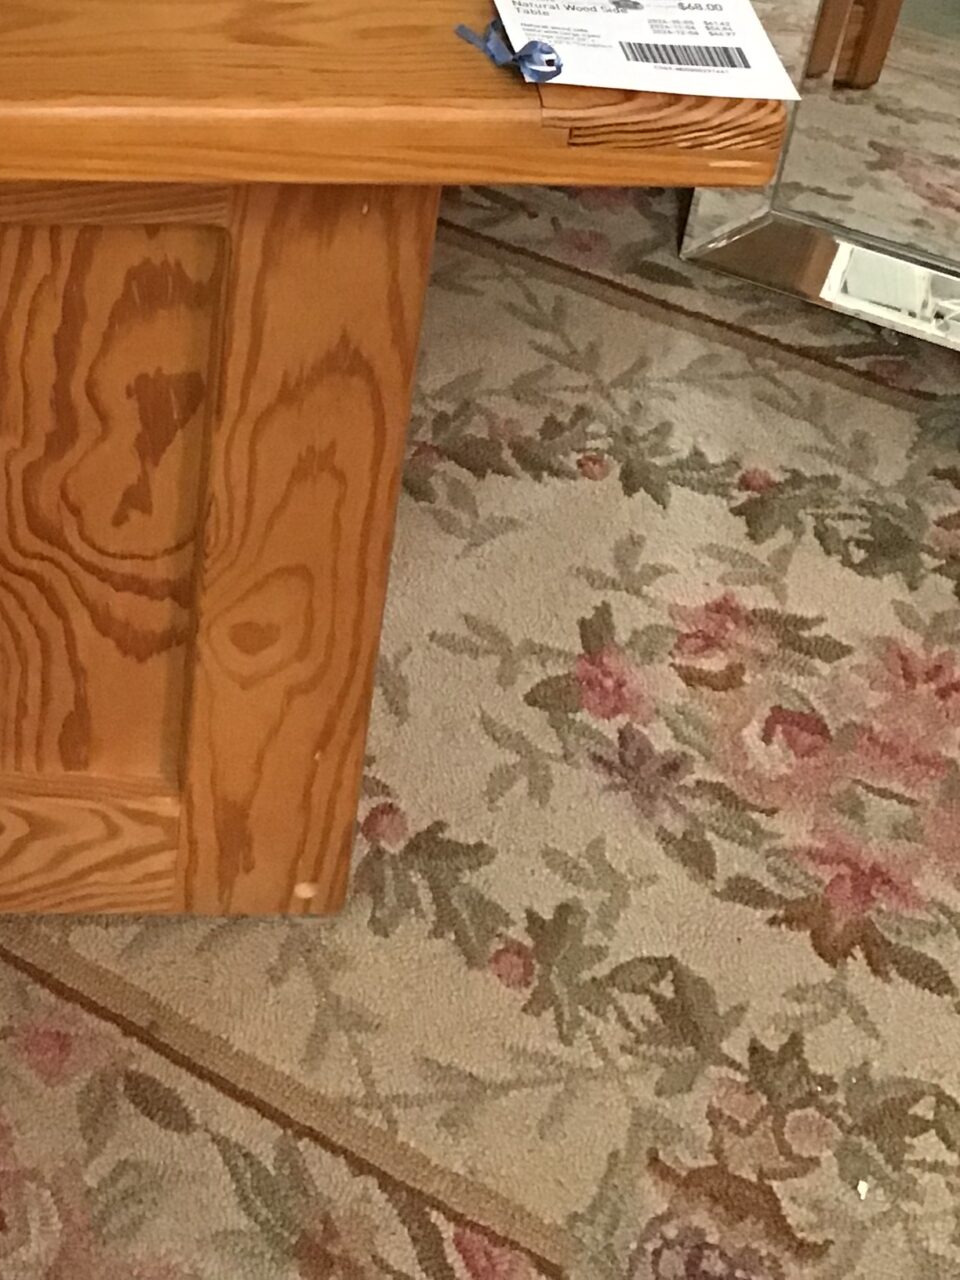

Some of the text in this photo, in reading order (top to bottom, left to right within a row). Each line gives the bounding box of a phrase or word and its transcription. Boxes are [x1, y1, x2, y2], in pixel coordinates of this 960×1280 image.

[512, 0, 560, 11] Natural
[564, 4, 597, 12] Wood
[677, 2, 723, 11] $68.00
[516, 8, 550, 16] Table
